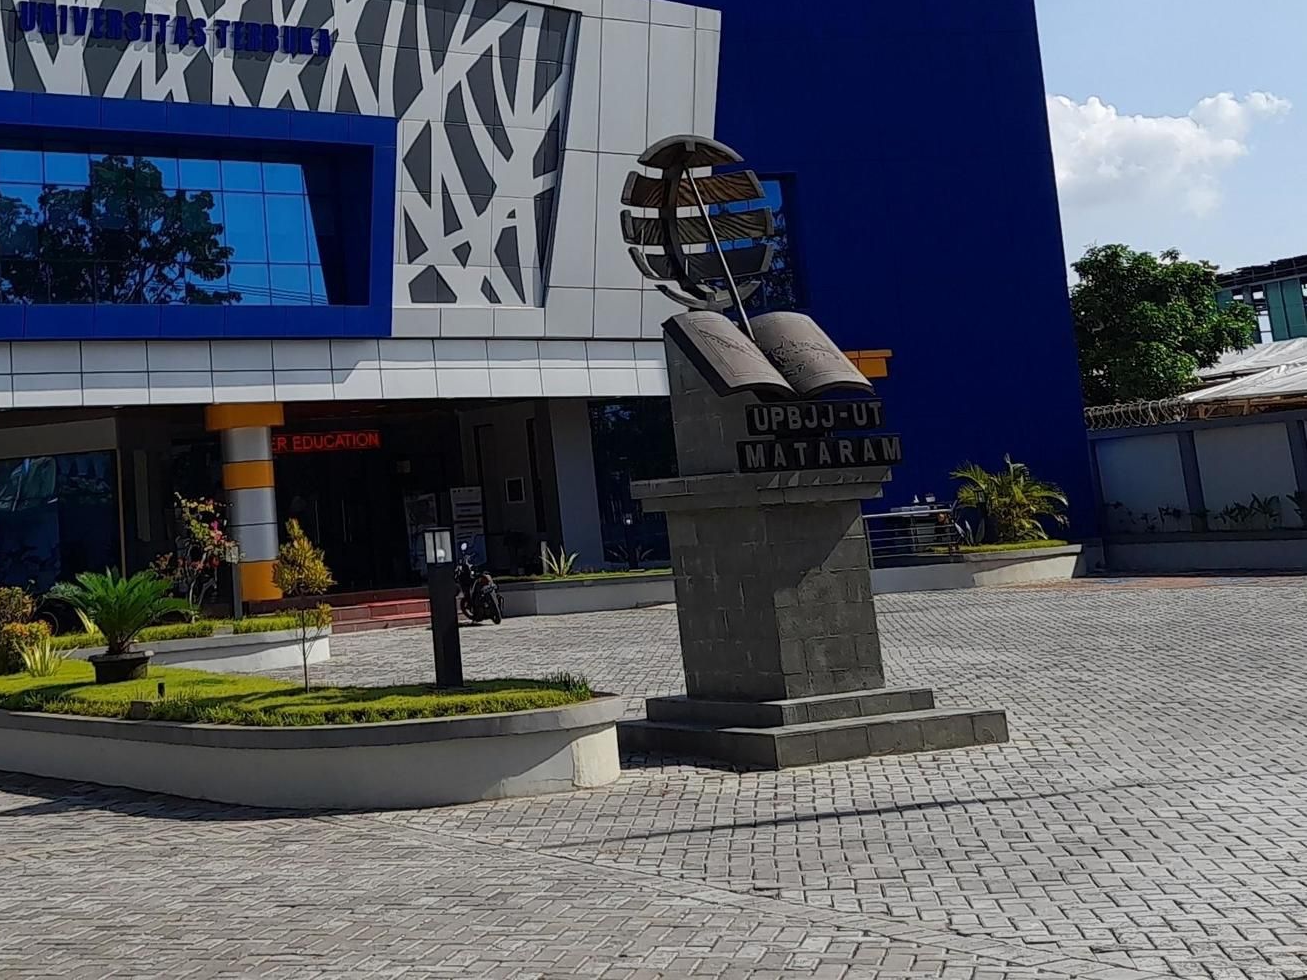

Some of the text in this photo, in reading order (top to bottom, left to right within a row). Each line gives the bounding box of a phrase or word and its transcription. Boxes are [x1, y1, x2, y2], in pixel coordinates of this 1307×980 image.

[18, 1, 332, 57] UNIVERSITAS TERBUKA
[753, 403, 882, 432] UPBJJ-UT
[293, 432, 379, 450] EDUCATION
[745, 437, 902, 468] MATARAM
